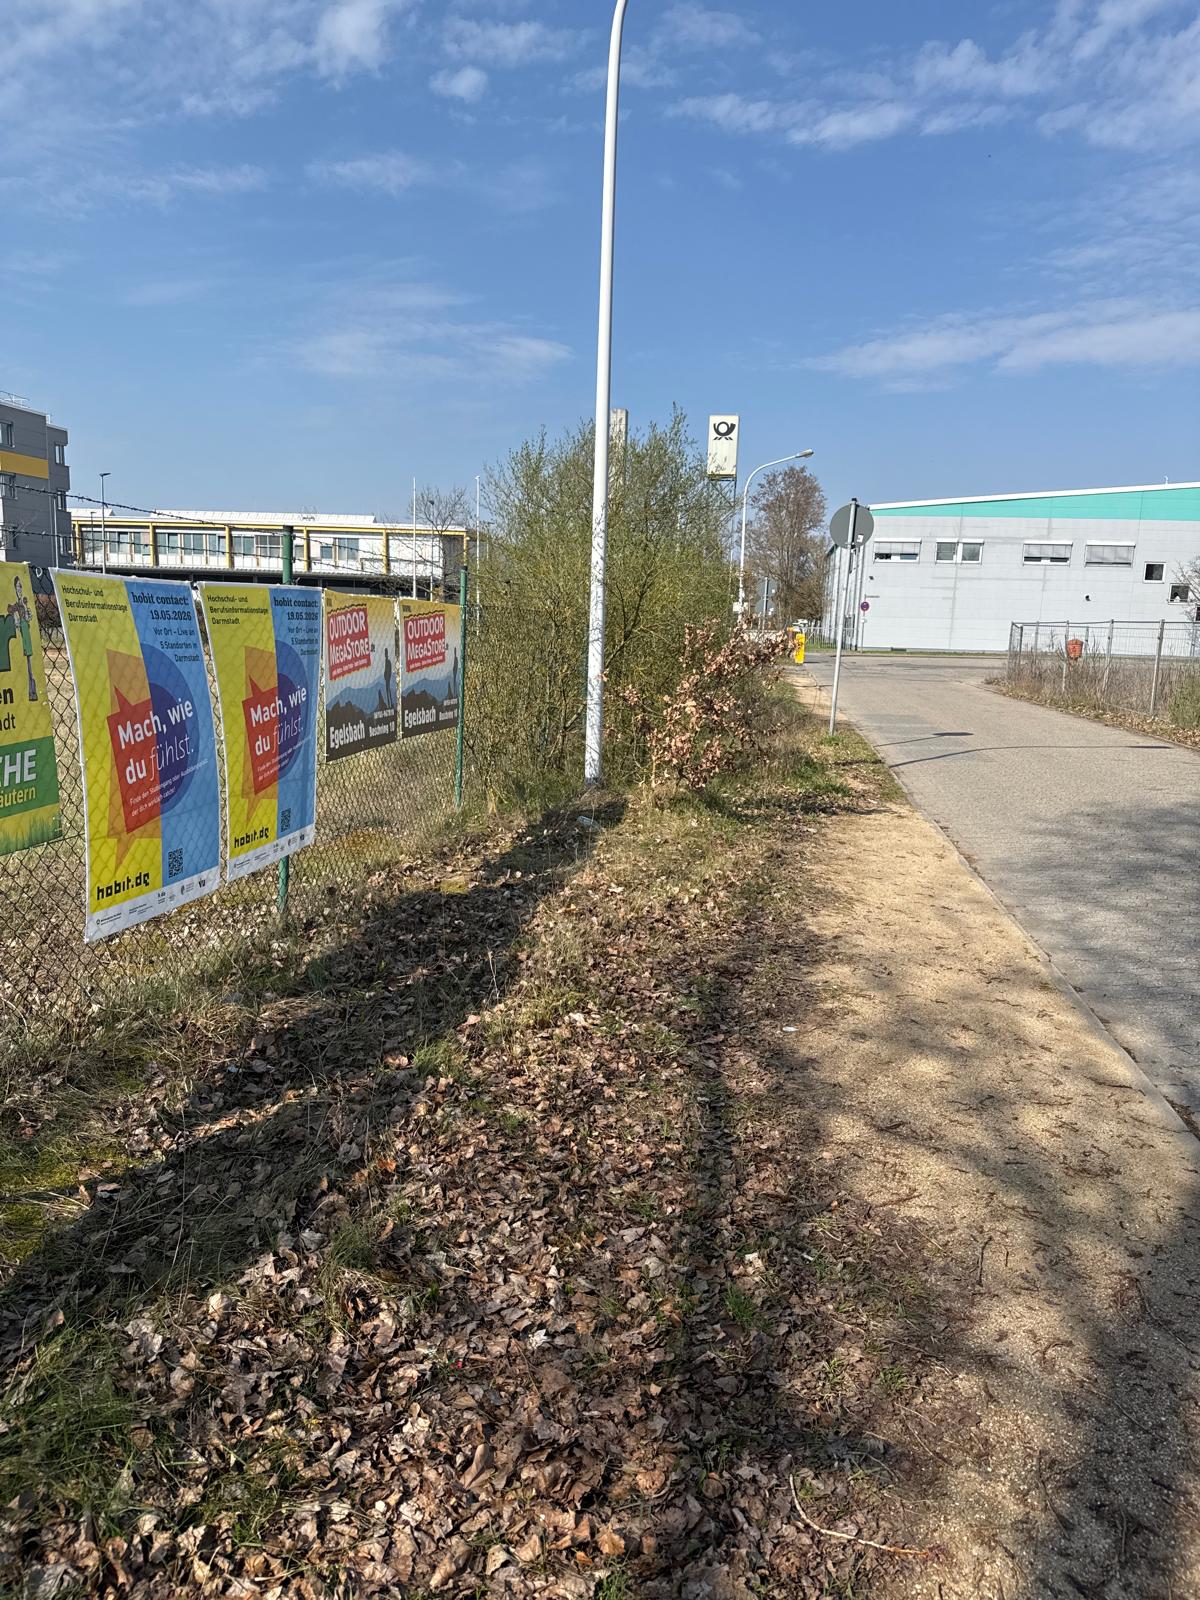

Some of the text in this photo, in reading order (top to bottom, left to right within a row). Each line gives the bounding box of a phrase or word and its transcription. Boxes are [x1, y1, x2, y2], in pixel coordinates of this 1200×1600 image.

[62, 585, 104, 597] Hochschul- und
[131, 592, 190, 606] hobit contact:
[207, 594, 237, 603] Hochschul-
[273, 596, 293, 608] hobit
[65, 599, 128, 613] Berufsinformationstage
[68, 613, 98, 623] Darmstadt
[150, 609, 192, 621] 19.05.2026
[212, 617, 241, 625] Darmstadt
[287, 611, 319, 621] 19.05.2026
[154, 627, 162, 636] Vor
[163, 627, 172, 636] Ort
[177, 627, 188, 637] Live
[189, 629, 196, 637] an
[329, 611, 366, 641] OUTDOOR
[407, 616, 444, 641] OUTDOOR
[164, 640, 192, 651] Standorten
[174, 653, 200, 663] Darmstadt
[250, 685, 307, 728] Mach, wie
[117, 698, 194, 750] Mach, wie
[404, 706, 437, 729] Egelsbach
[255, 735, 271, 756] du
[272, 717, 304, 754] fühlst.
[329, 720, 366, 750] Egelsbach
[125, 733, 194, 785] du fühlst.
[0, 748, 37, 787] HE
[234, 826, 270, 849] hobit.de
[96, 871, 150, 901] hobit.de
